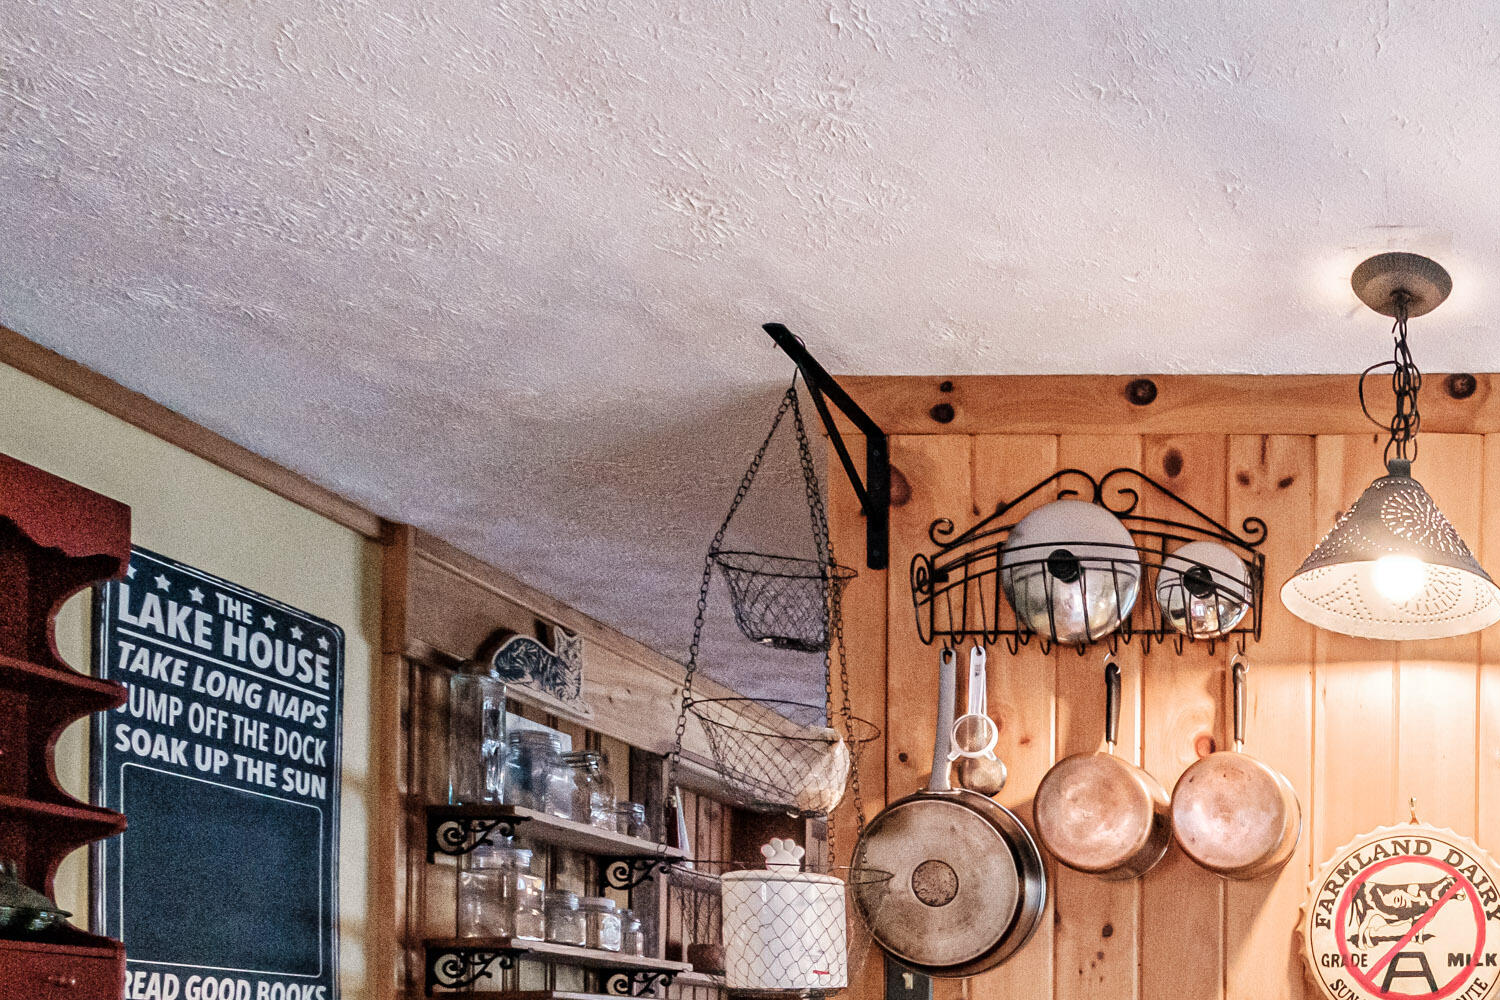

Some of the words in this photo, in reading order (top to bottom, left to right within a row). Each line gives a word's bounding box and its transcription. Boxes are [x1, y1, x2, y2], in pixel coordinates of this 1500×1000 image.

[117, 583, 213, 650] LAKE
[223, 621, 330, 690] HOUSE
[215, 591, 253, 625] THE
[118, 641, 189, 687] TAKE
[192, 665, 262, 709] LONG
[267, 689, 328, 729] NAPS
[114, 723, 189, 766] SOAK
[194, 744, 229, 775] UP
[233, 754, 277, 788] THE
[281, 767, 326, 800] SUN
[188, 702, 228, 740] OFF
[232, 713, 269, 752] THE
[274, 726, 328, 768] DOCK
[1315, 838, 1432, 930] FARMLAND
[1321, 953, 1368, 968] GRADE
[1447, 953, 1498, 967] MILK
